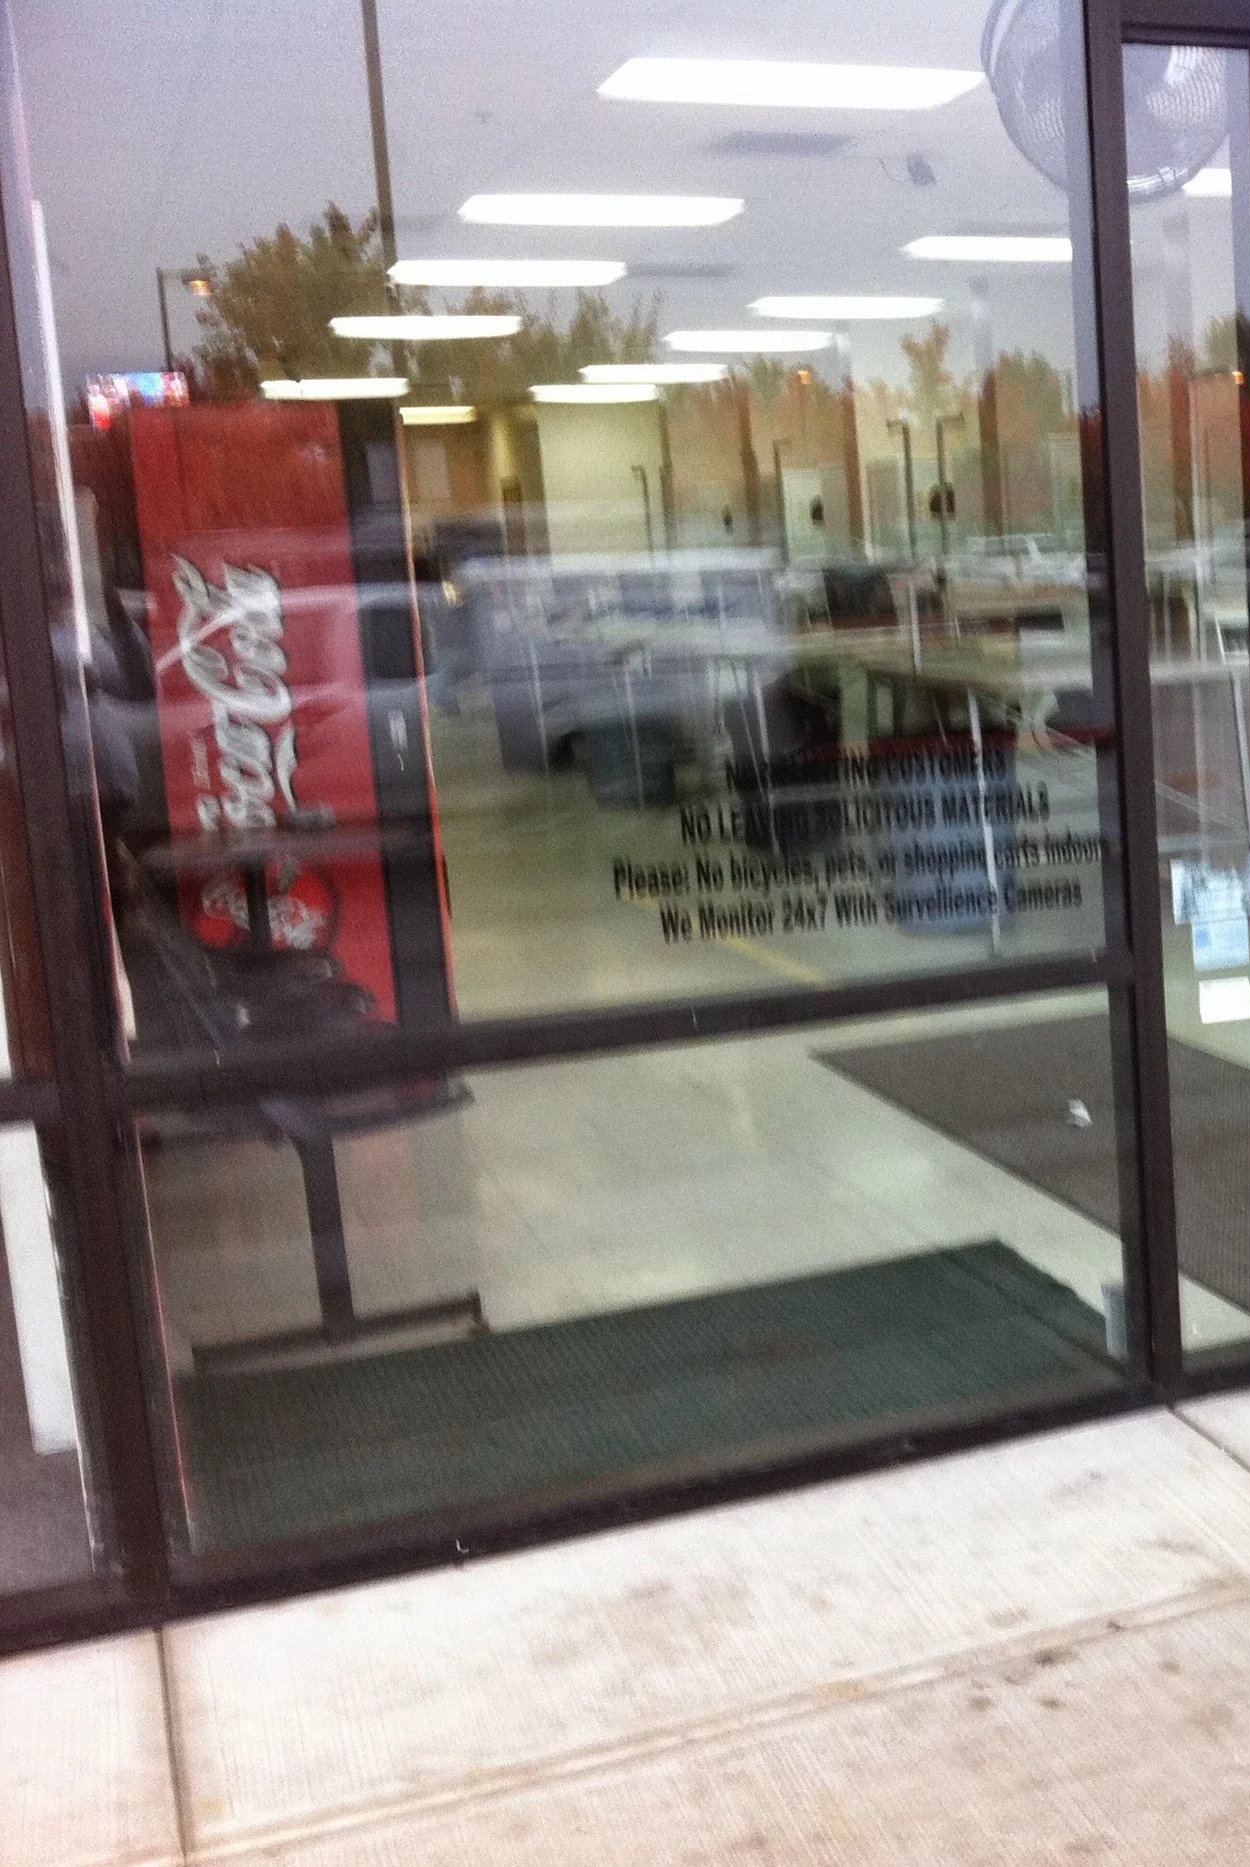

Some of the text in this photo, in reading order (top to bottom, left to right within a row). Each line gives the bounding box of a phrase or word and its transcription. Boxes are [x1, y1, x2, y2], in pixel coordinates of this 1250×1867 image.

[696, 850, 725, 894] No
[660, 901, 694, 944] We
[698, 897, 775, 942] Monitor
